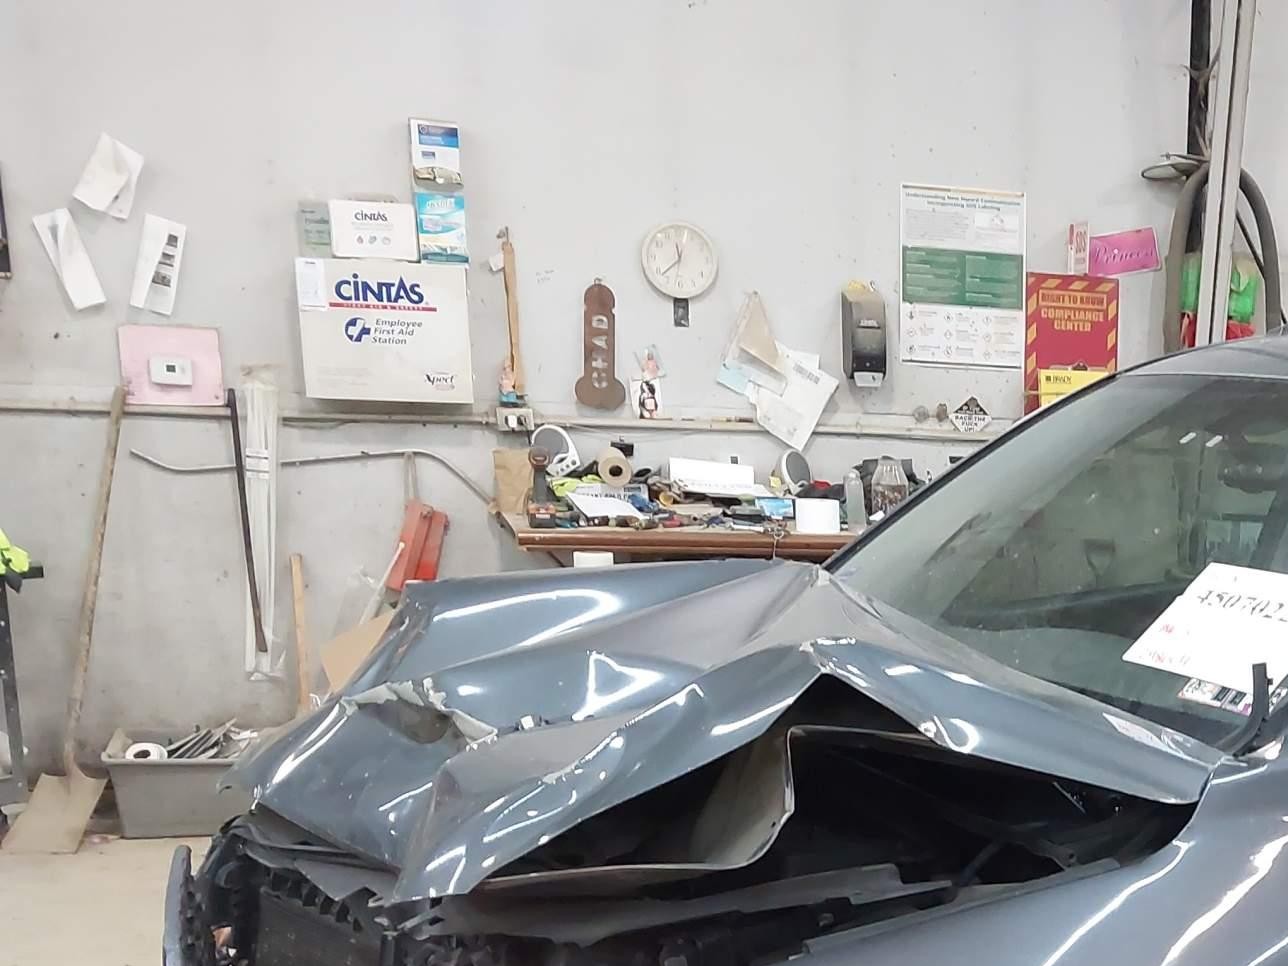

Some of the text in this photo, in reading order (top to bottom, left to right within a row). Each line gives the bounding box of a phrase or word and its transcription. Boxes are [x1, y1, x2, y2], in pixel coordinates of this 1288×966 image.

[1067, 294, 1078, 304] TO
[1041, 307, 1104, 322] COMPLIANCE
[374, 326, 415, 337] First Aid
[375, 318, 423, 332] Employee
[1054, 319, 1092, 332] CENTER
[371, 335, 407, 345] Station
[591, 315, 609, 389] CHAD
